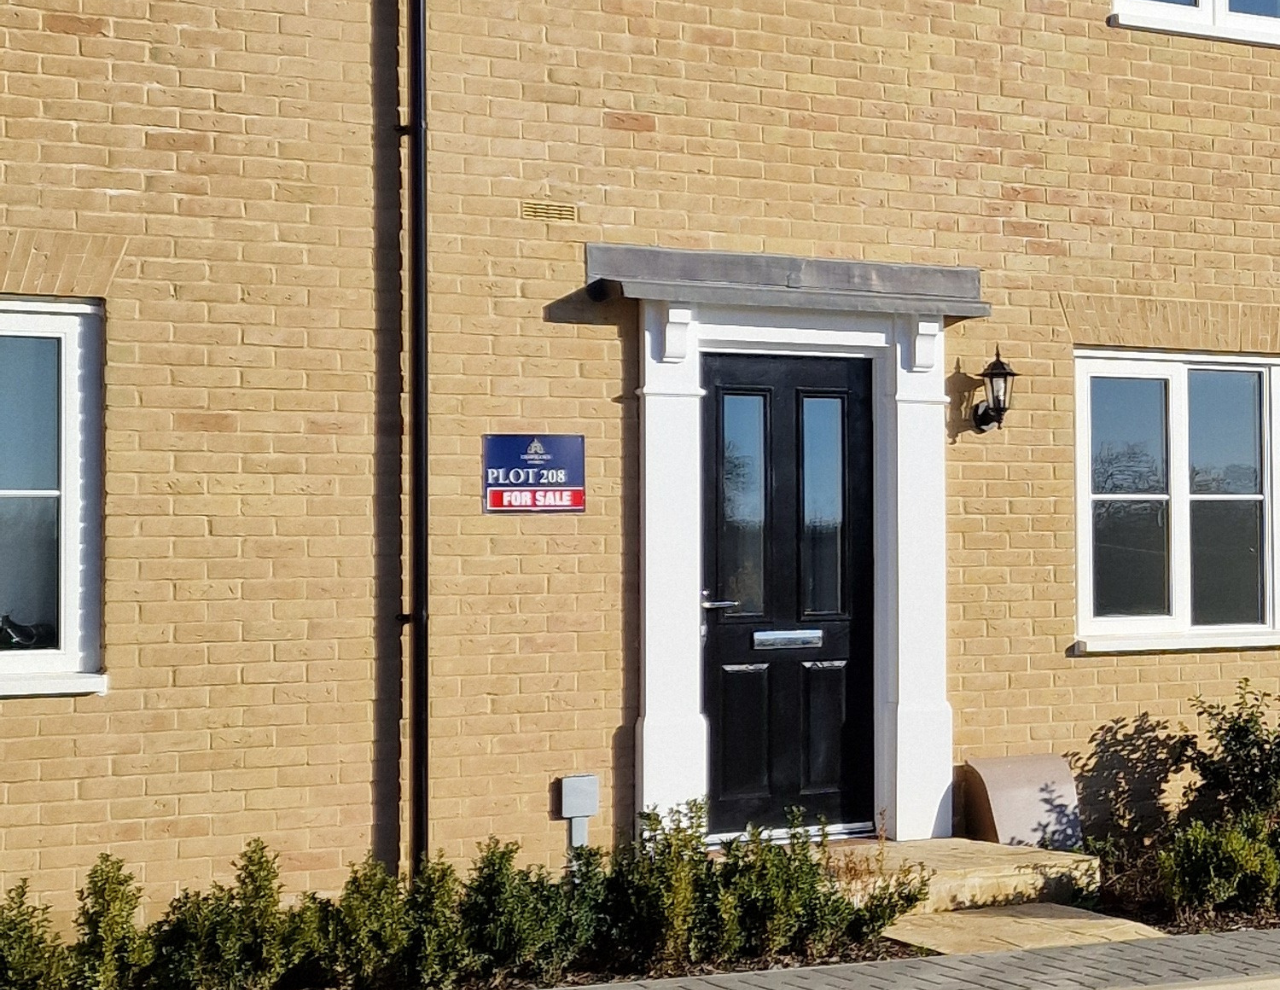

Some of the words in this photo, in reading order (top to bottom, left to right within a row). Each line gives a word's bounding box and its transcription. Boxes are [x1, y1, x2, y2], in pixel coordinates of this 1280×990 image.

[487, 468, 537, 483] PLOT
[539, 469, 565, 483] 208
[502, 491, 532, 506] FOR
[535, 491, 572, 506] SALE
